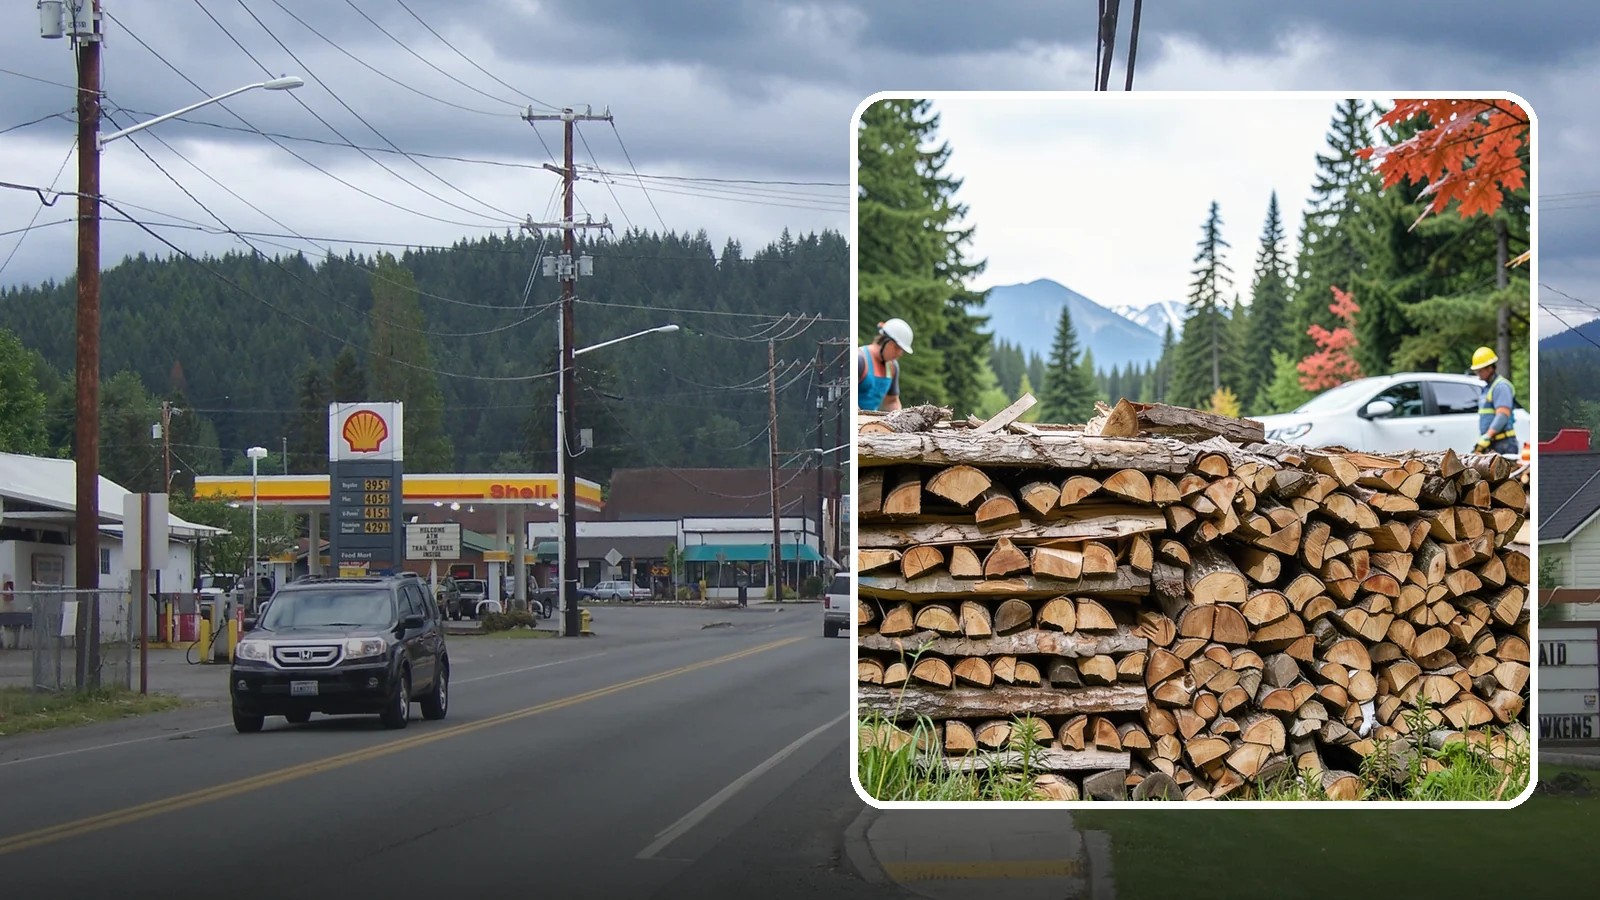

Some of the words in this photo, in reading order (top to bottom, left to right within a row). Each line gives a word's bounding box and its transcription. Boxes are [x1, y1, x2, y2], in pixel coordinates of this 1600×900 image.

[365, 480, 384, 490] 395
[490, 484, 547, 499] Shell
[365, 494, 384, 504] 405
[365, 508, 384, 518] 415
[365, 522, 384, 533] 429
